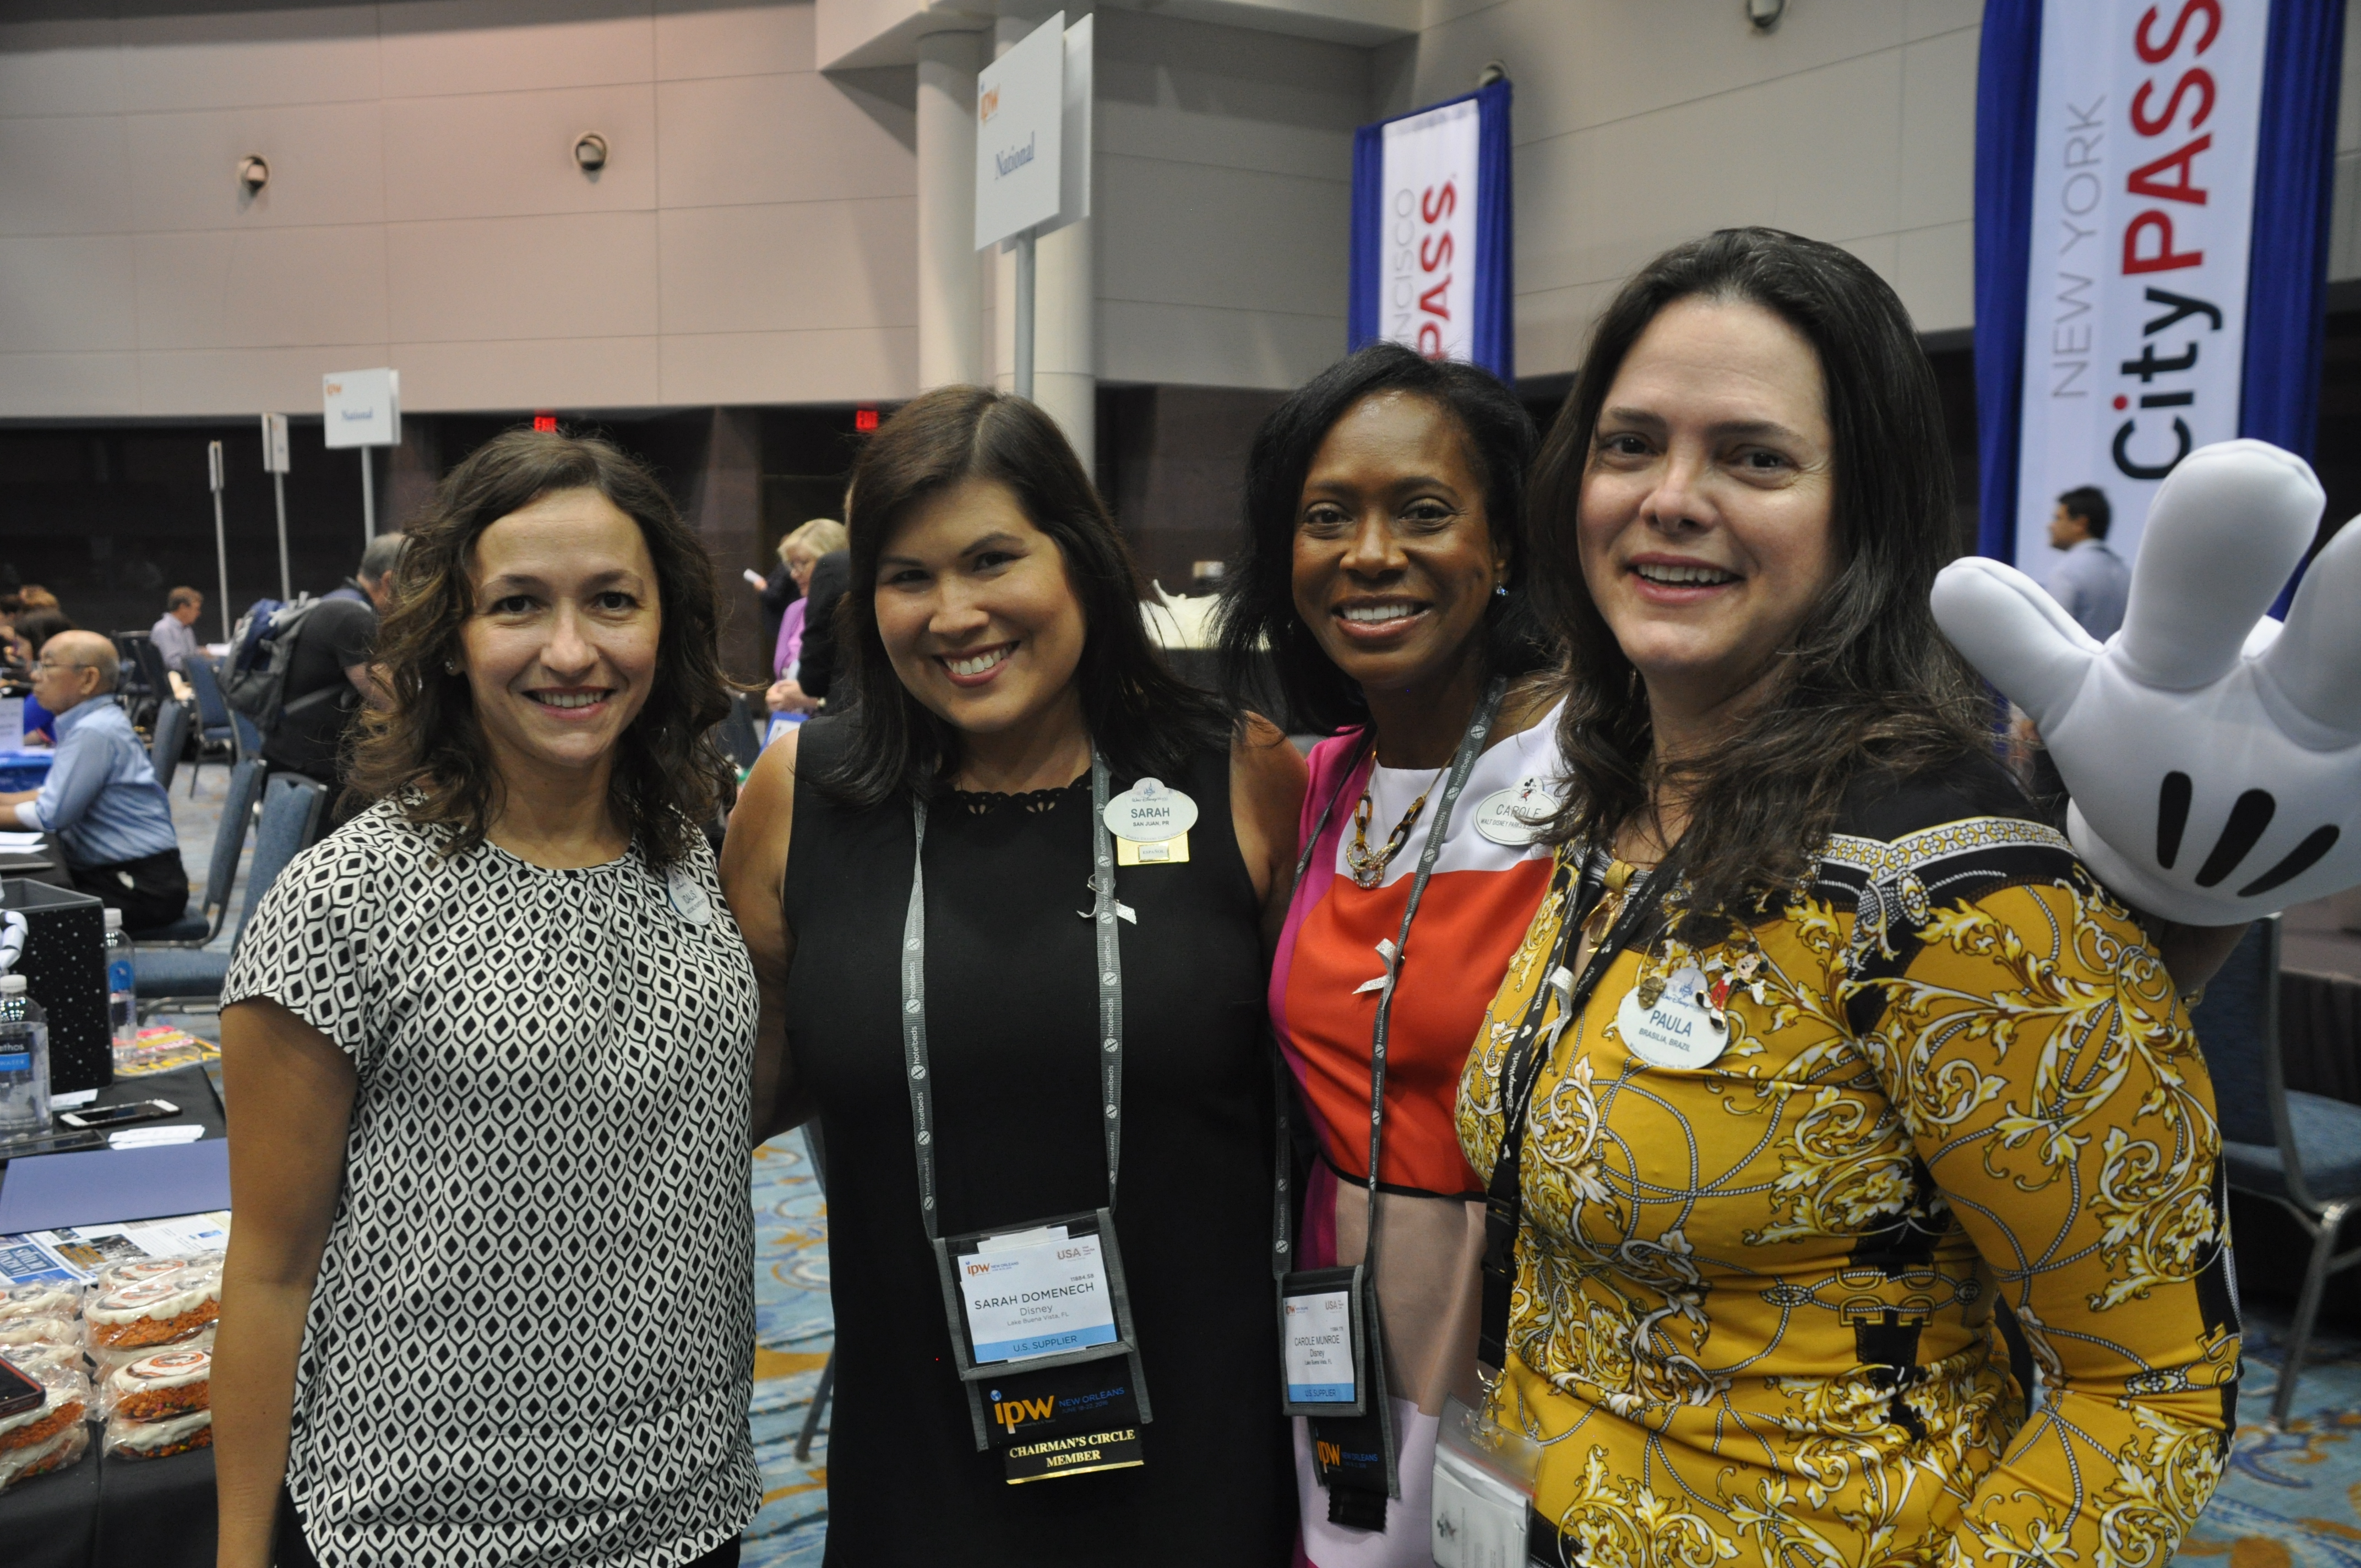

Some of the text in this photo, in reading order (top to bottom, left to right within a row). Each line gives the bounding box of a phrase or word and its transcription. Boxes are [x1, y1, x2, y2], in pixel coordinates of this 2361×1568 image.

[995, 130, 1035, 179] National
[2052, 95, 2107, 399] NEW YORK
[1454, 750, 1473, 786] hotelbeds
[1131, 807, 1170, 818] SARAH
[1430, 811, 1447, 848] hotelbeds
[1532, 961, 1555, 1012] Disneyland
[1650, 1010, 1693, 1037] PAULA
[911, 1026, 920, 1064] hotelbeds
[1639, 1028, 1690, 1052] BRASILIA, BRAZIL
[1057, 1248, 1081, 1260] USA
[966, 1261, 990, 1277] ipw
[975, 1282, 1095, 1310] SARAH DOMENECH
[1325, 1300, 1338, 1310] USA
[1020, 1305, 1053, 1316] Disney
[1013, 1335, 1078, 1352] U.S. SUPPLIER
[1294, 1335, 1340, 1346] CAROLE MUNROE
[1310, 1349, 1325, 1358] Disney
[1059, 1387, 1125, 1407] NEW ORLEANS
[991, 1390, 1054, 1434] ipw
[1009, 1429, 1135, 1458] CHAIRMAN'S CIRCLE
[1046, 1450, 1101, 1467] MEMBER
[1351, 1452, 1378, 1462] ORLEANS
